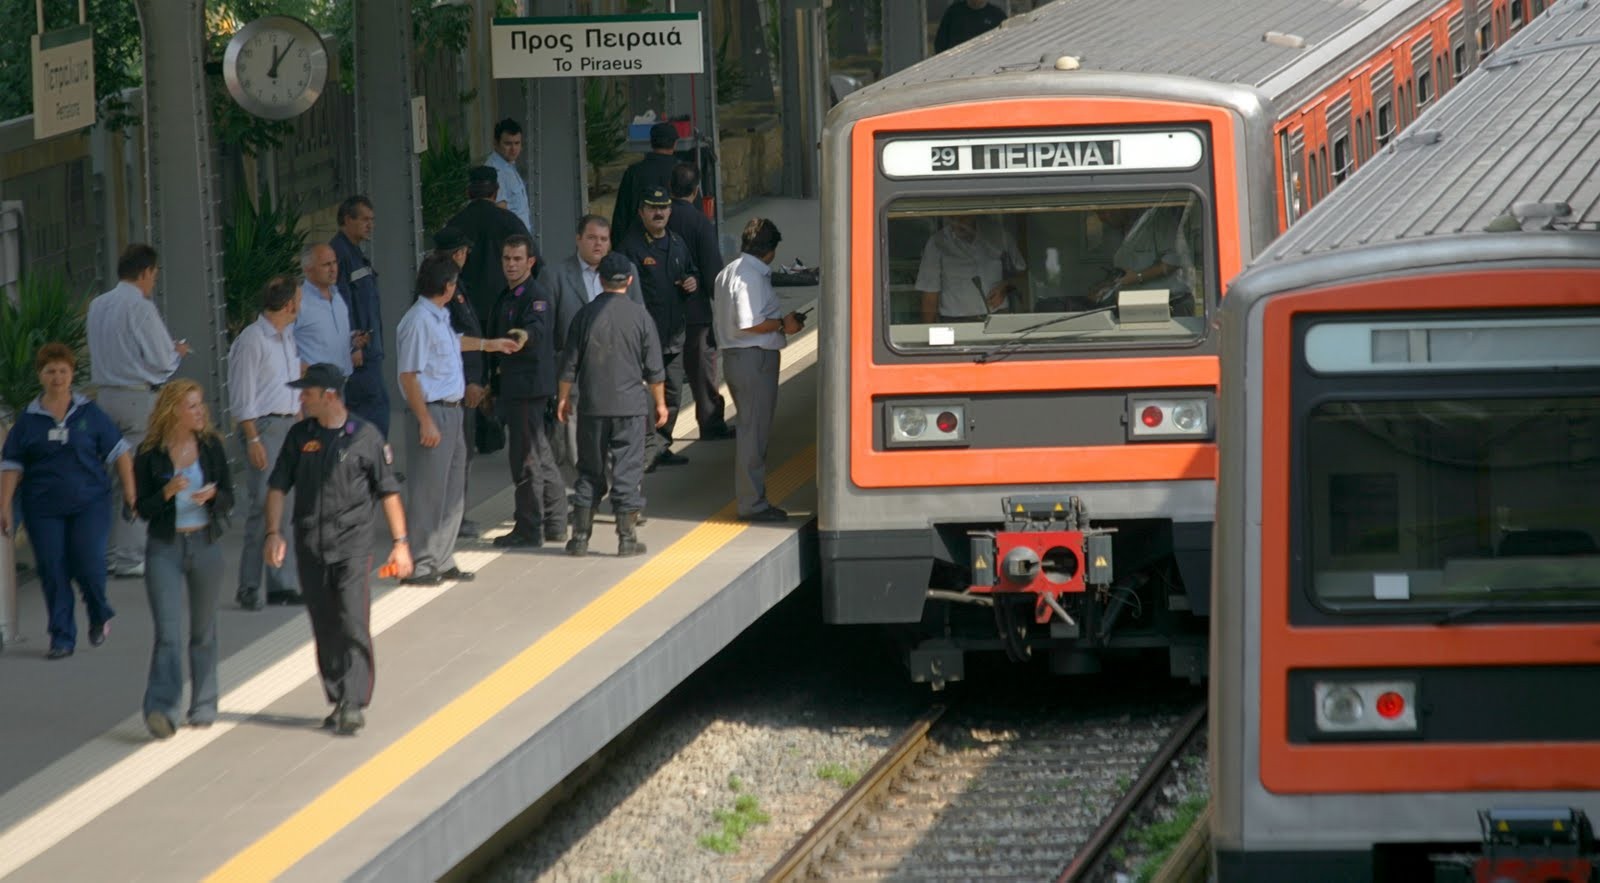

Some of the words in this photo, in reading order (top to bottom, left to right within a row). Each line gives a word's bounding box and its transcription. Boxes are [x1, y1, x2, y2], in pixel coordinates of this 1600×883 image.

[511, 31, 573, 54] Προς
[585, 27, 682, 51] Πειραιά
[553, 58, 572, 71] To
[580, 56, 642, 71] Piraeus
[932, 148, 956, 166] 29
[984, 142, 1105, 169] ΠΕΙΡΑΙΑ
